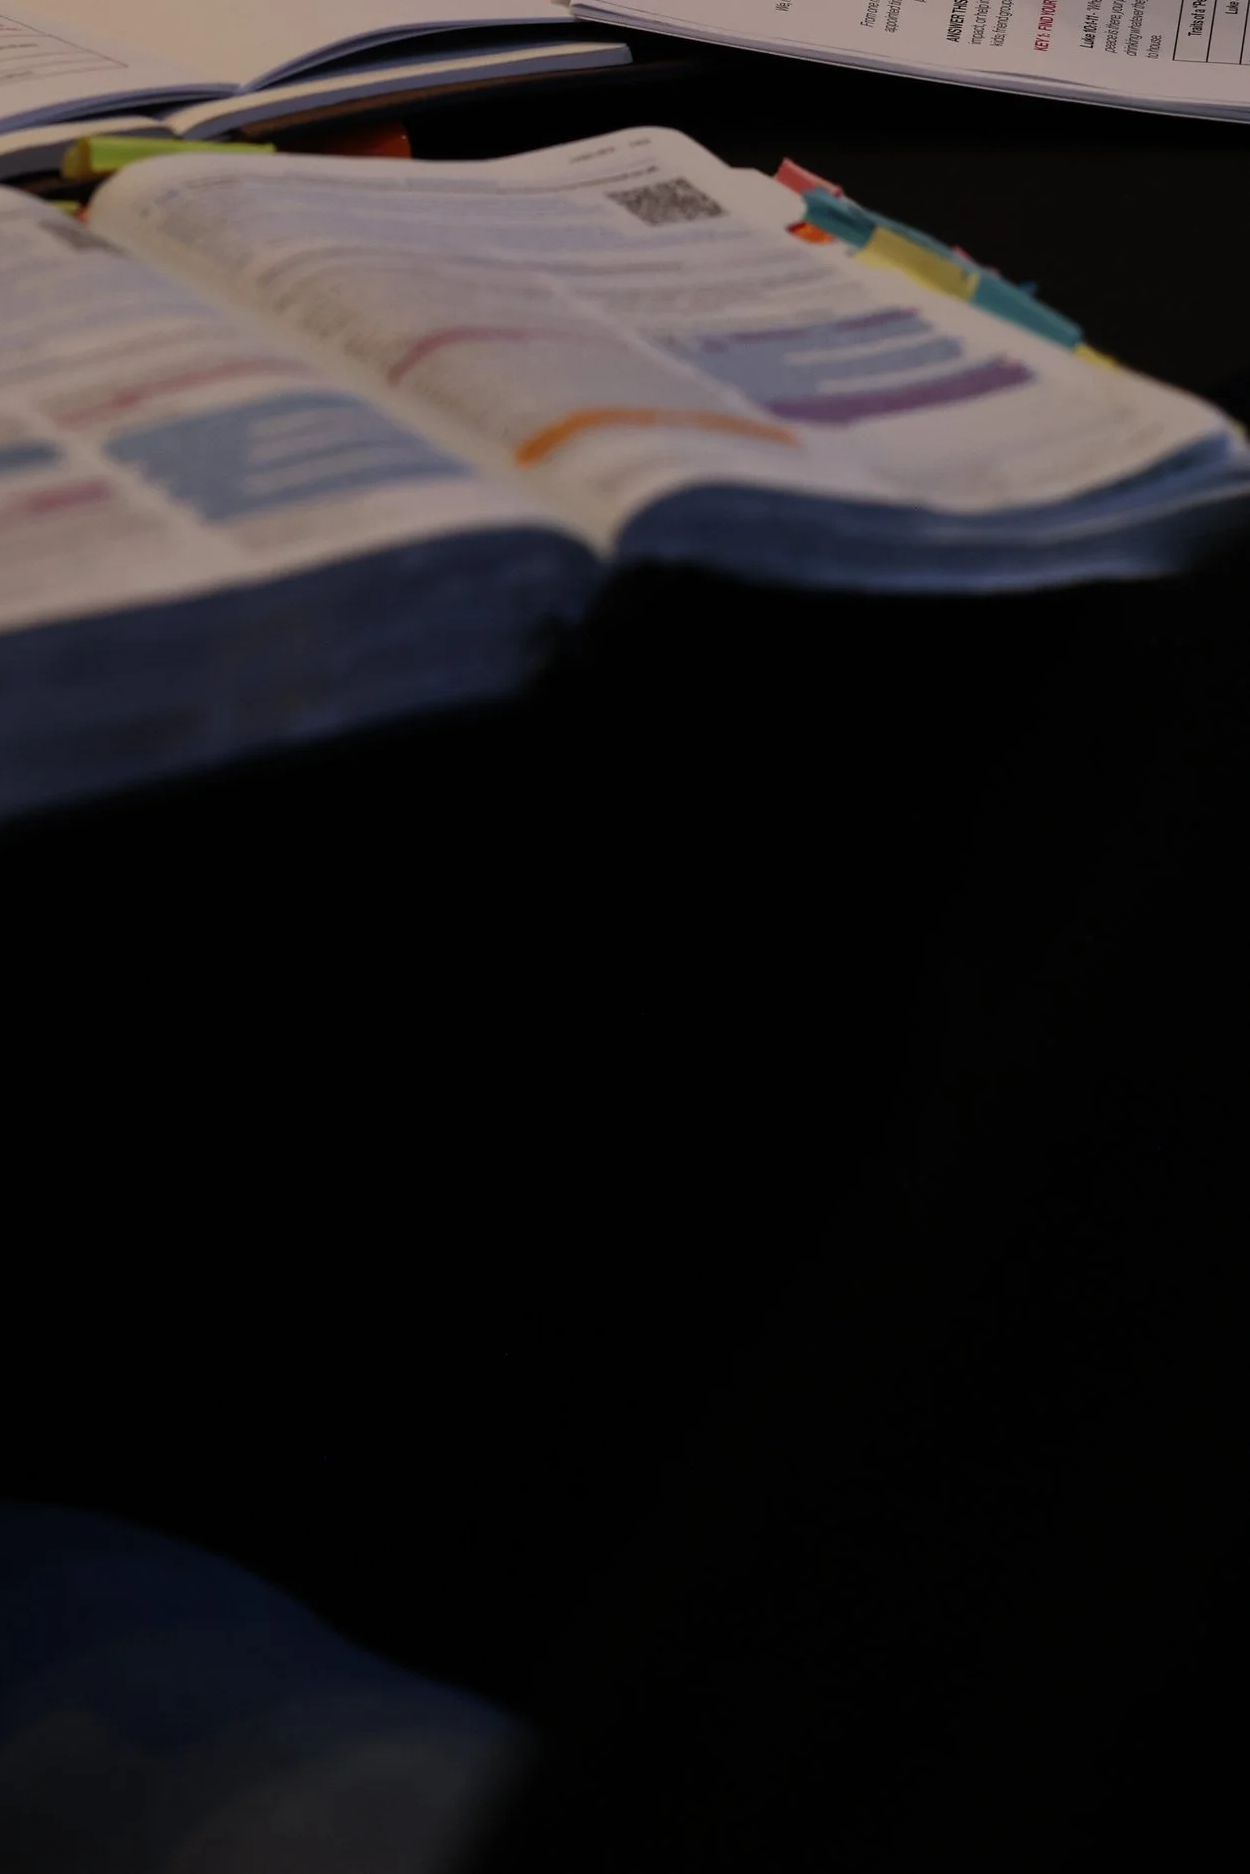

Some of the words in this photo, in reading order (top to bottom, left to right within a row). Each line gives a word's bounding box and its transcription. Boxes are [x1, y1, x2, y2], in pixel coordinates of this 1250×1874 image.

[952, 0, 968, 13] THIS
[1041, 0, 1057, 16] YOUR
[1225, 1, 1239, 15] Luke
[946, 14, 964, 42] ANSWER
[1038, 16, 1054, 31] FIND
[1083, 14, 1099, 33] 10:1-11
[1188, 19, 1204, 36] Traits
[1034, 37, 1050, 52] KEY
[1080, 33, 1096, 49] Luke
